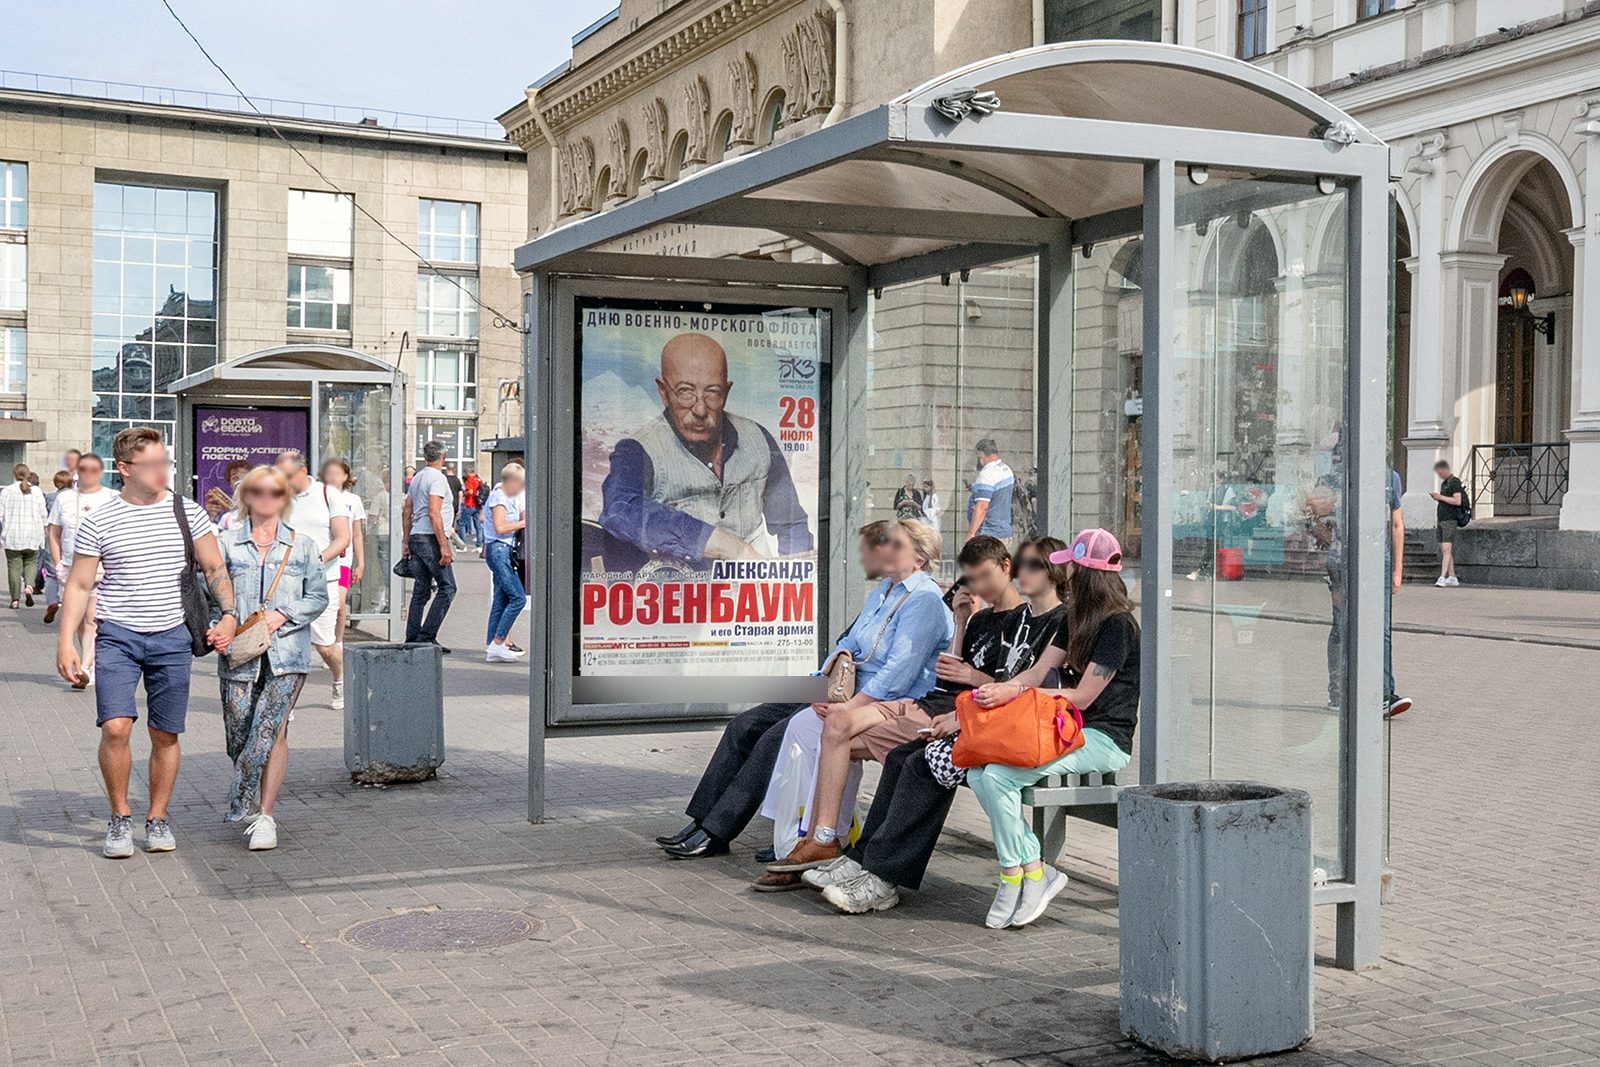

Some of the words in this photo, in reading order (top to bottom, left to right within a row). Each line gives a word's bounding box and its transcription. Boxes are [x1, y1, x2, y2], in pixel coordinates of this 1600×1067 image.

[587, 311, 620, 327] ДНЮ
[625, 313, 764, 334] ВОЕННО-МОРСКОГО
[769, 321, 817, 335] ФЛОТА
[779, 396, 816, 429] 28
[780, 430, 813, 441] ИЮЛЯ
[783, 442, 805, 451] 19.00
[583, 571, 633, 580] НАРОДНЫЙ
[672, 571, 708, 579] РОССИИ
[713, 561, 814, 581] АЛЕКСАНДР
[583, 582, 814, 625] РОЗЕНБАУМ
[718, 629, 732, 637] его
[734, 624, 775, 637] Старая
[777, 625, 814, 636] армия
[583, 652, 598, 666] 12+
